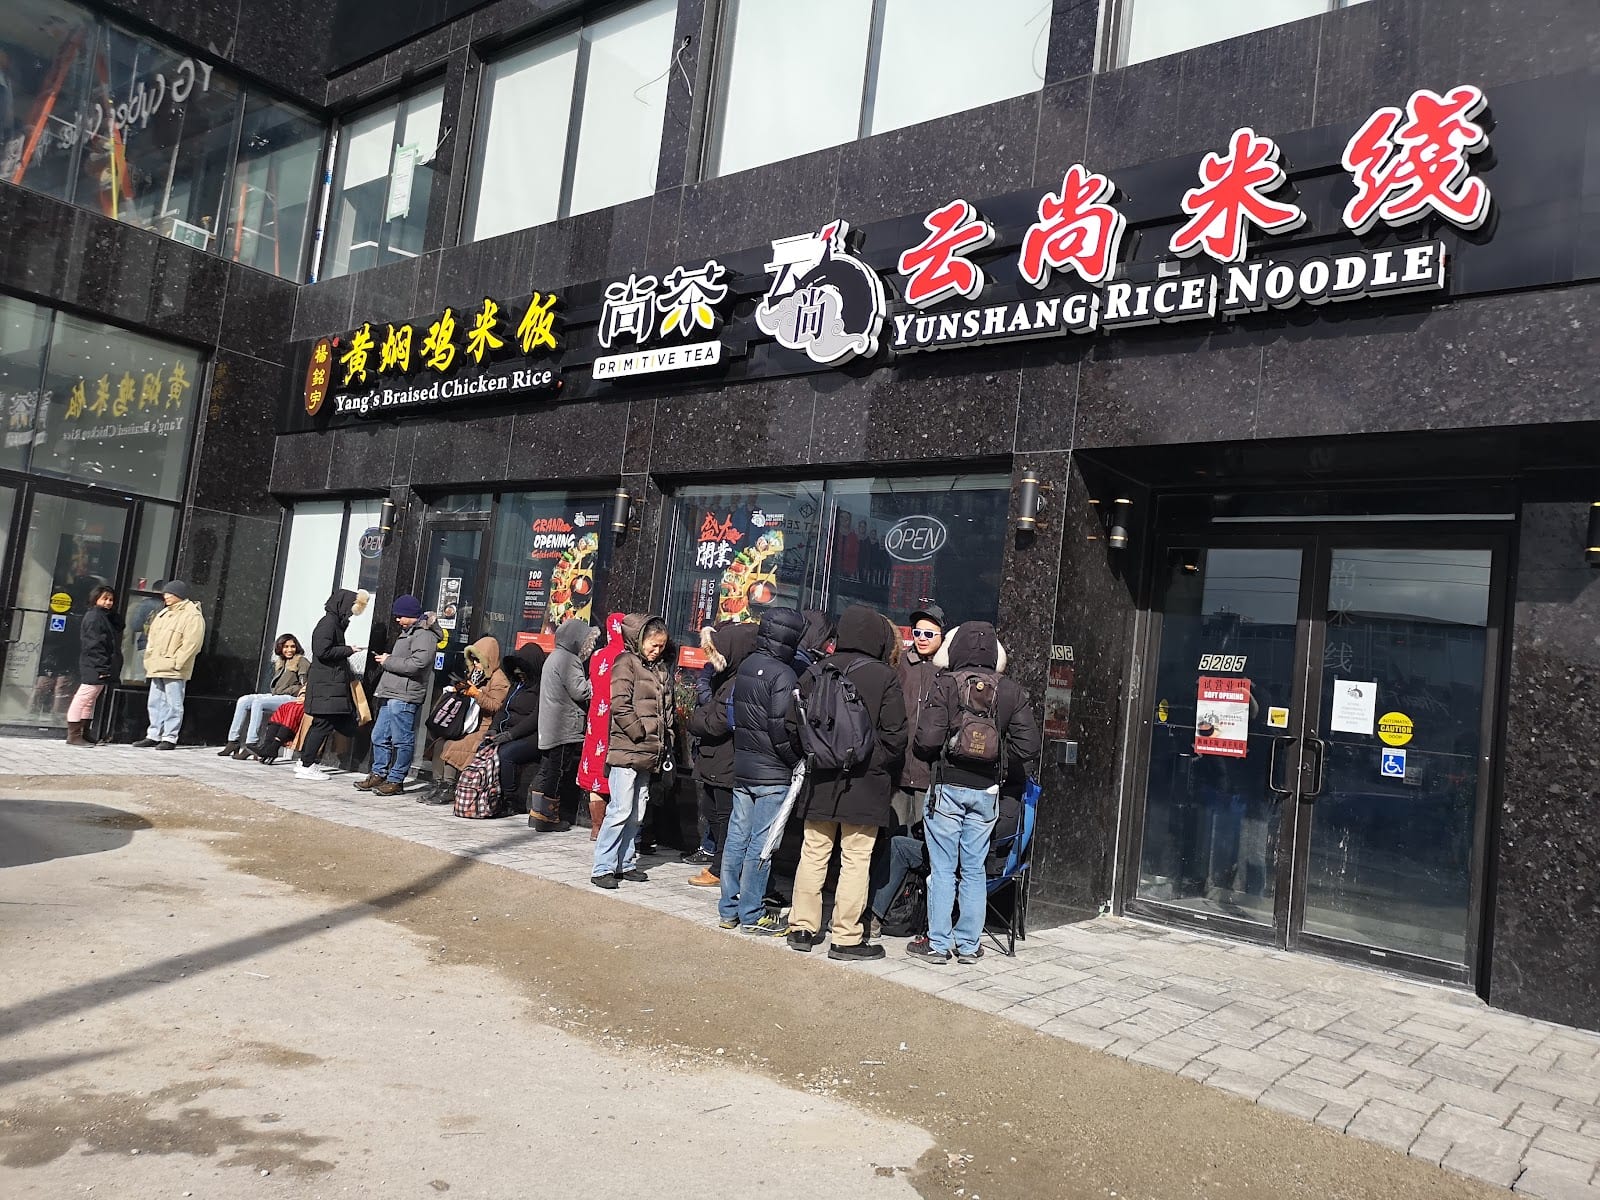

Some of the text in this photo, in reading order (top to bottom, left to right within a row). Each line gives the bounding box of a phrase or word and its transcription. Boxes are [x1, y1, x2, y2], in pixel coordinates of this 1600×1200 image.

[598, 259, 729, 348] 尚茶
[891, 244, 1436, 347] YUNSHANG RICE NOODLE
[340, 291, 559, 386] 黄焖鸡米饭
[598, 349, 715, 375] PRIMITIVE TEA
[334, 367, 552, 414] Yang's Braised Chicken Rice
[532, 517, 565, 533] GRAND
[360, 534, 385, 551] OPEN
[533, 533, 576, 549] OPENING
[887, 527, 941, 550] OPEN
[529, 571, 542, 580] 100
[1200, 655, 1246, 671] 5285
[1203, 691, 1244, 701] SOFT OPENING
[1380, 724, 1412, 734] CAUTION
